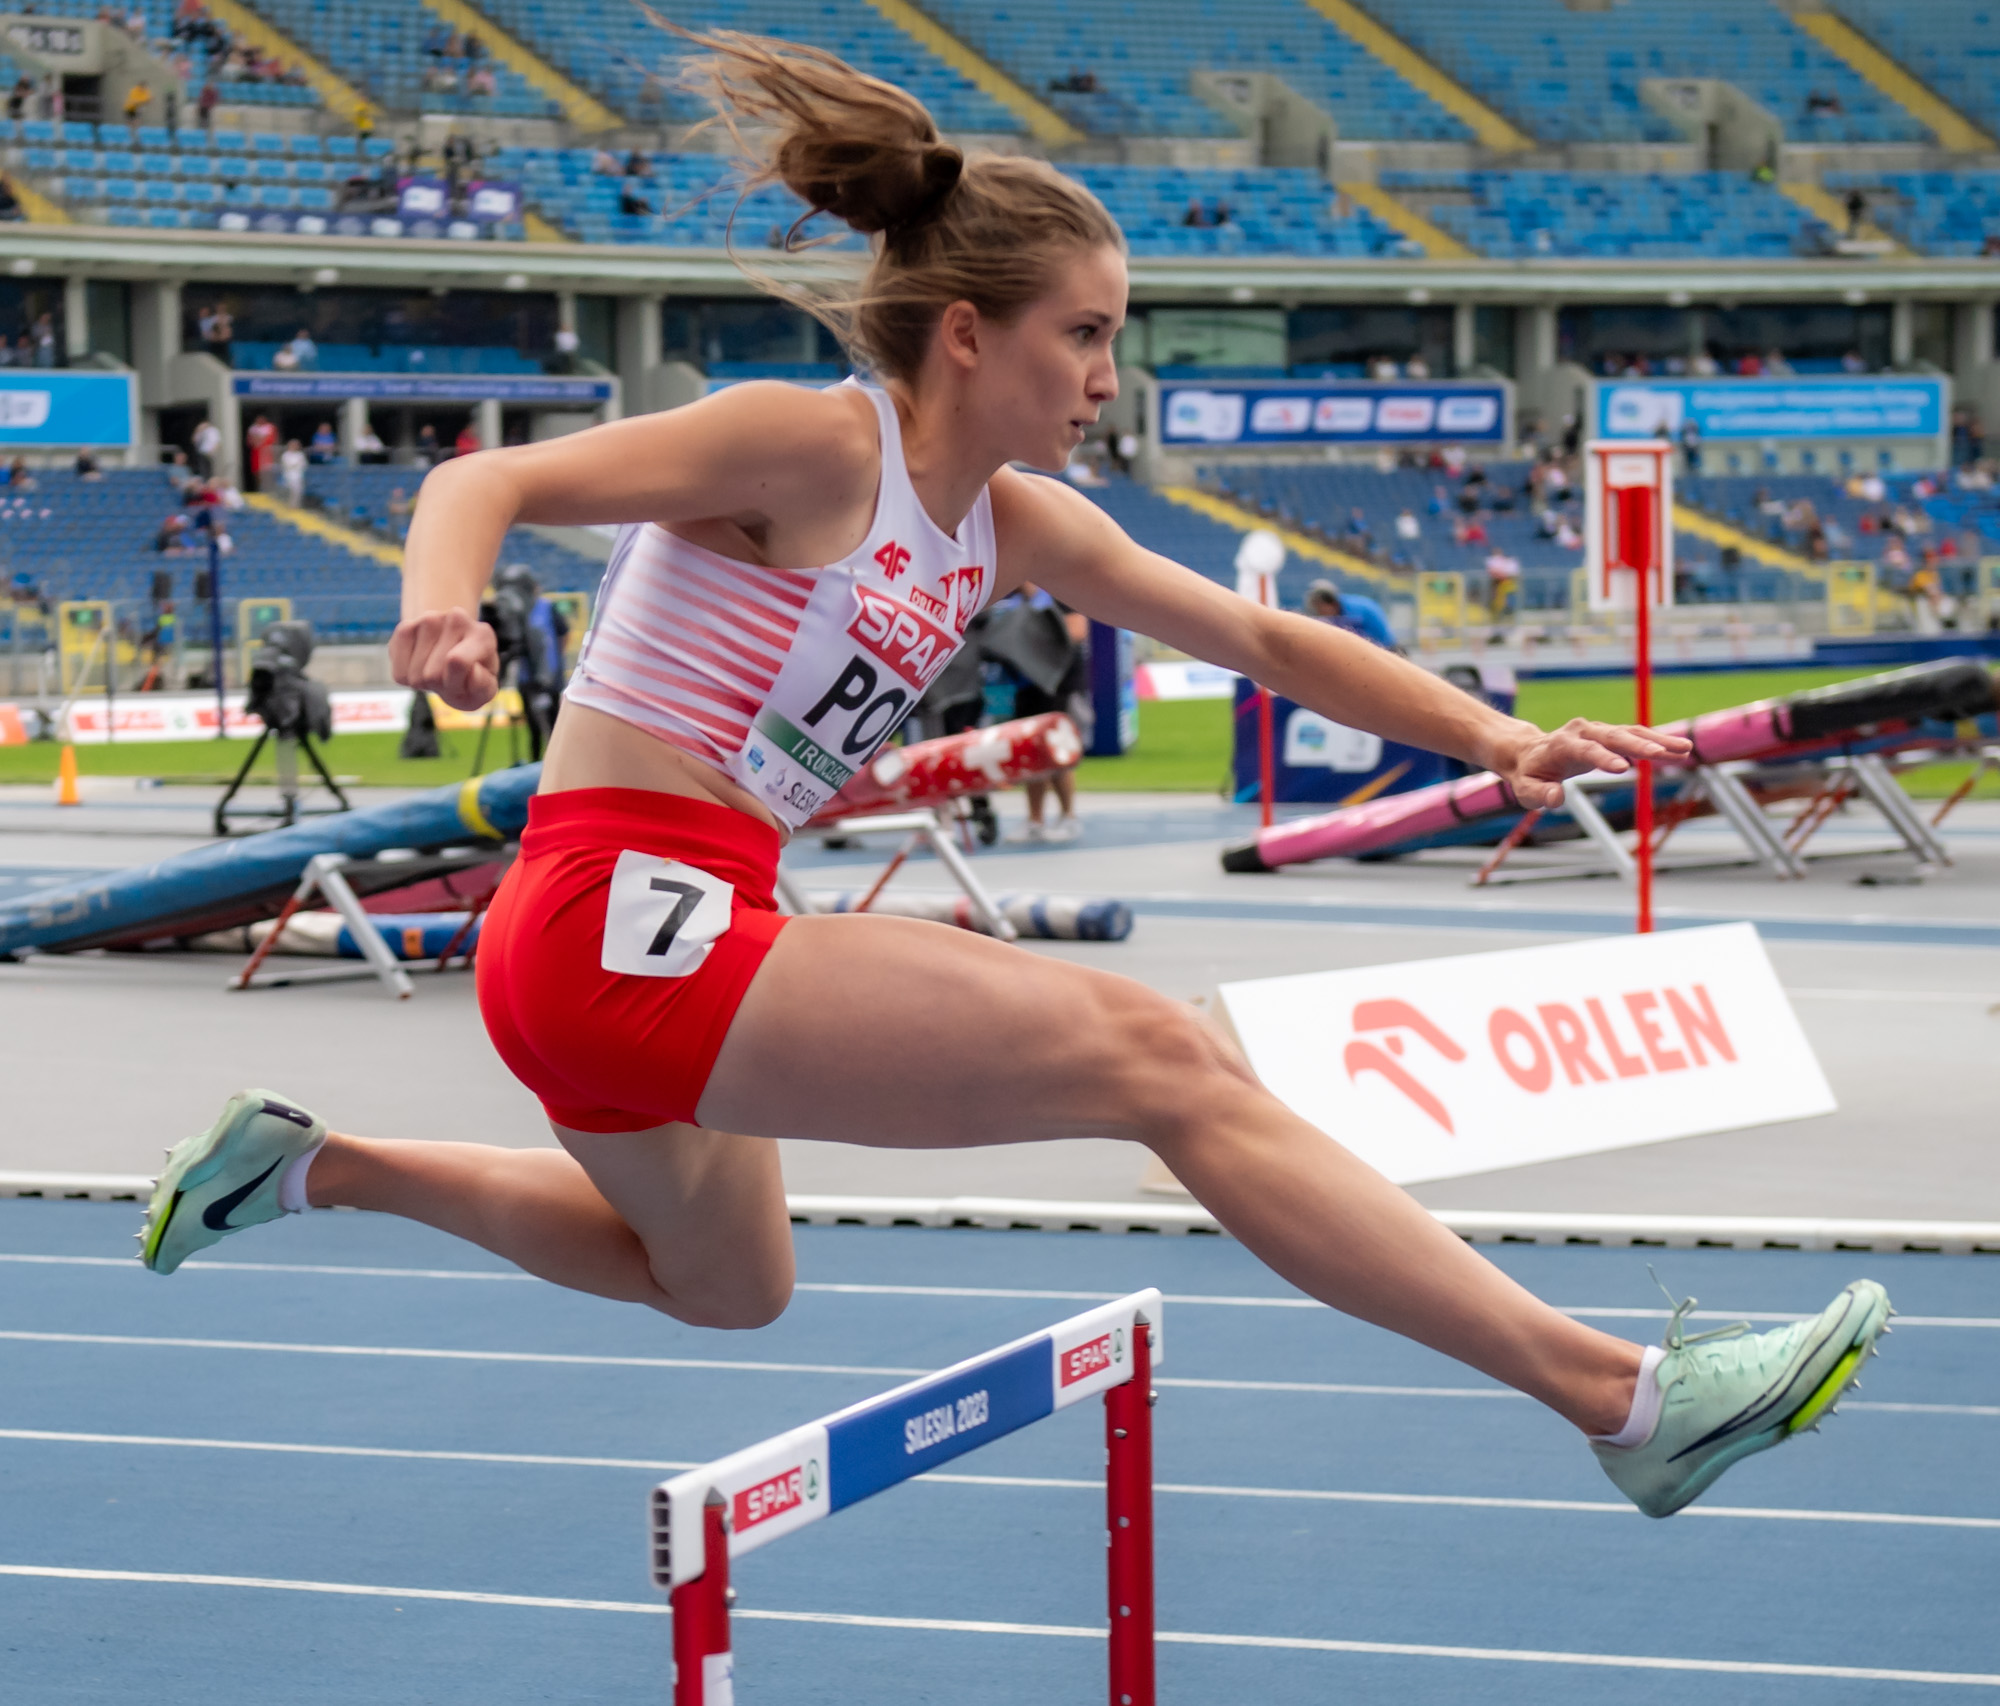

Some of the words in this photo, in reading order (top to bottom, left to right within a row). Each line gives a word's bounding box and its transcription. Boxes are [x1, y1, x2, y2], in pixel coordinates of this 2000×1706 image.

[874, 540, 912, 582] 4F
[912, 590, 948, 623] ORLEN
[645, 876, 706, 956] 7
[1488, 984, 1738, 1094] ORLEN
[1070, 1338, 1111, 1377] SPAR
[904, 1403, 956, 1455] SILESIA
[956, 1389, 989, 1433] 2023
[747, 1472, 803, 1521] SPAR
